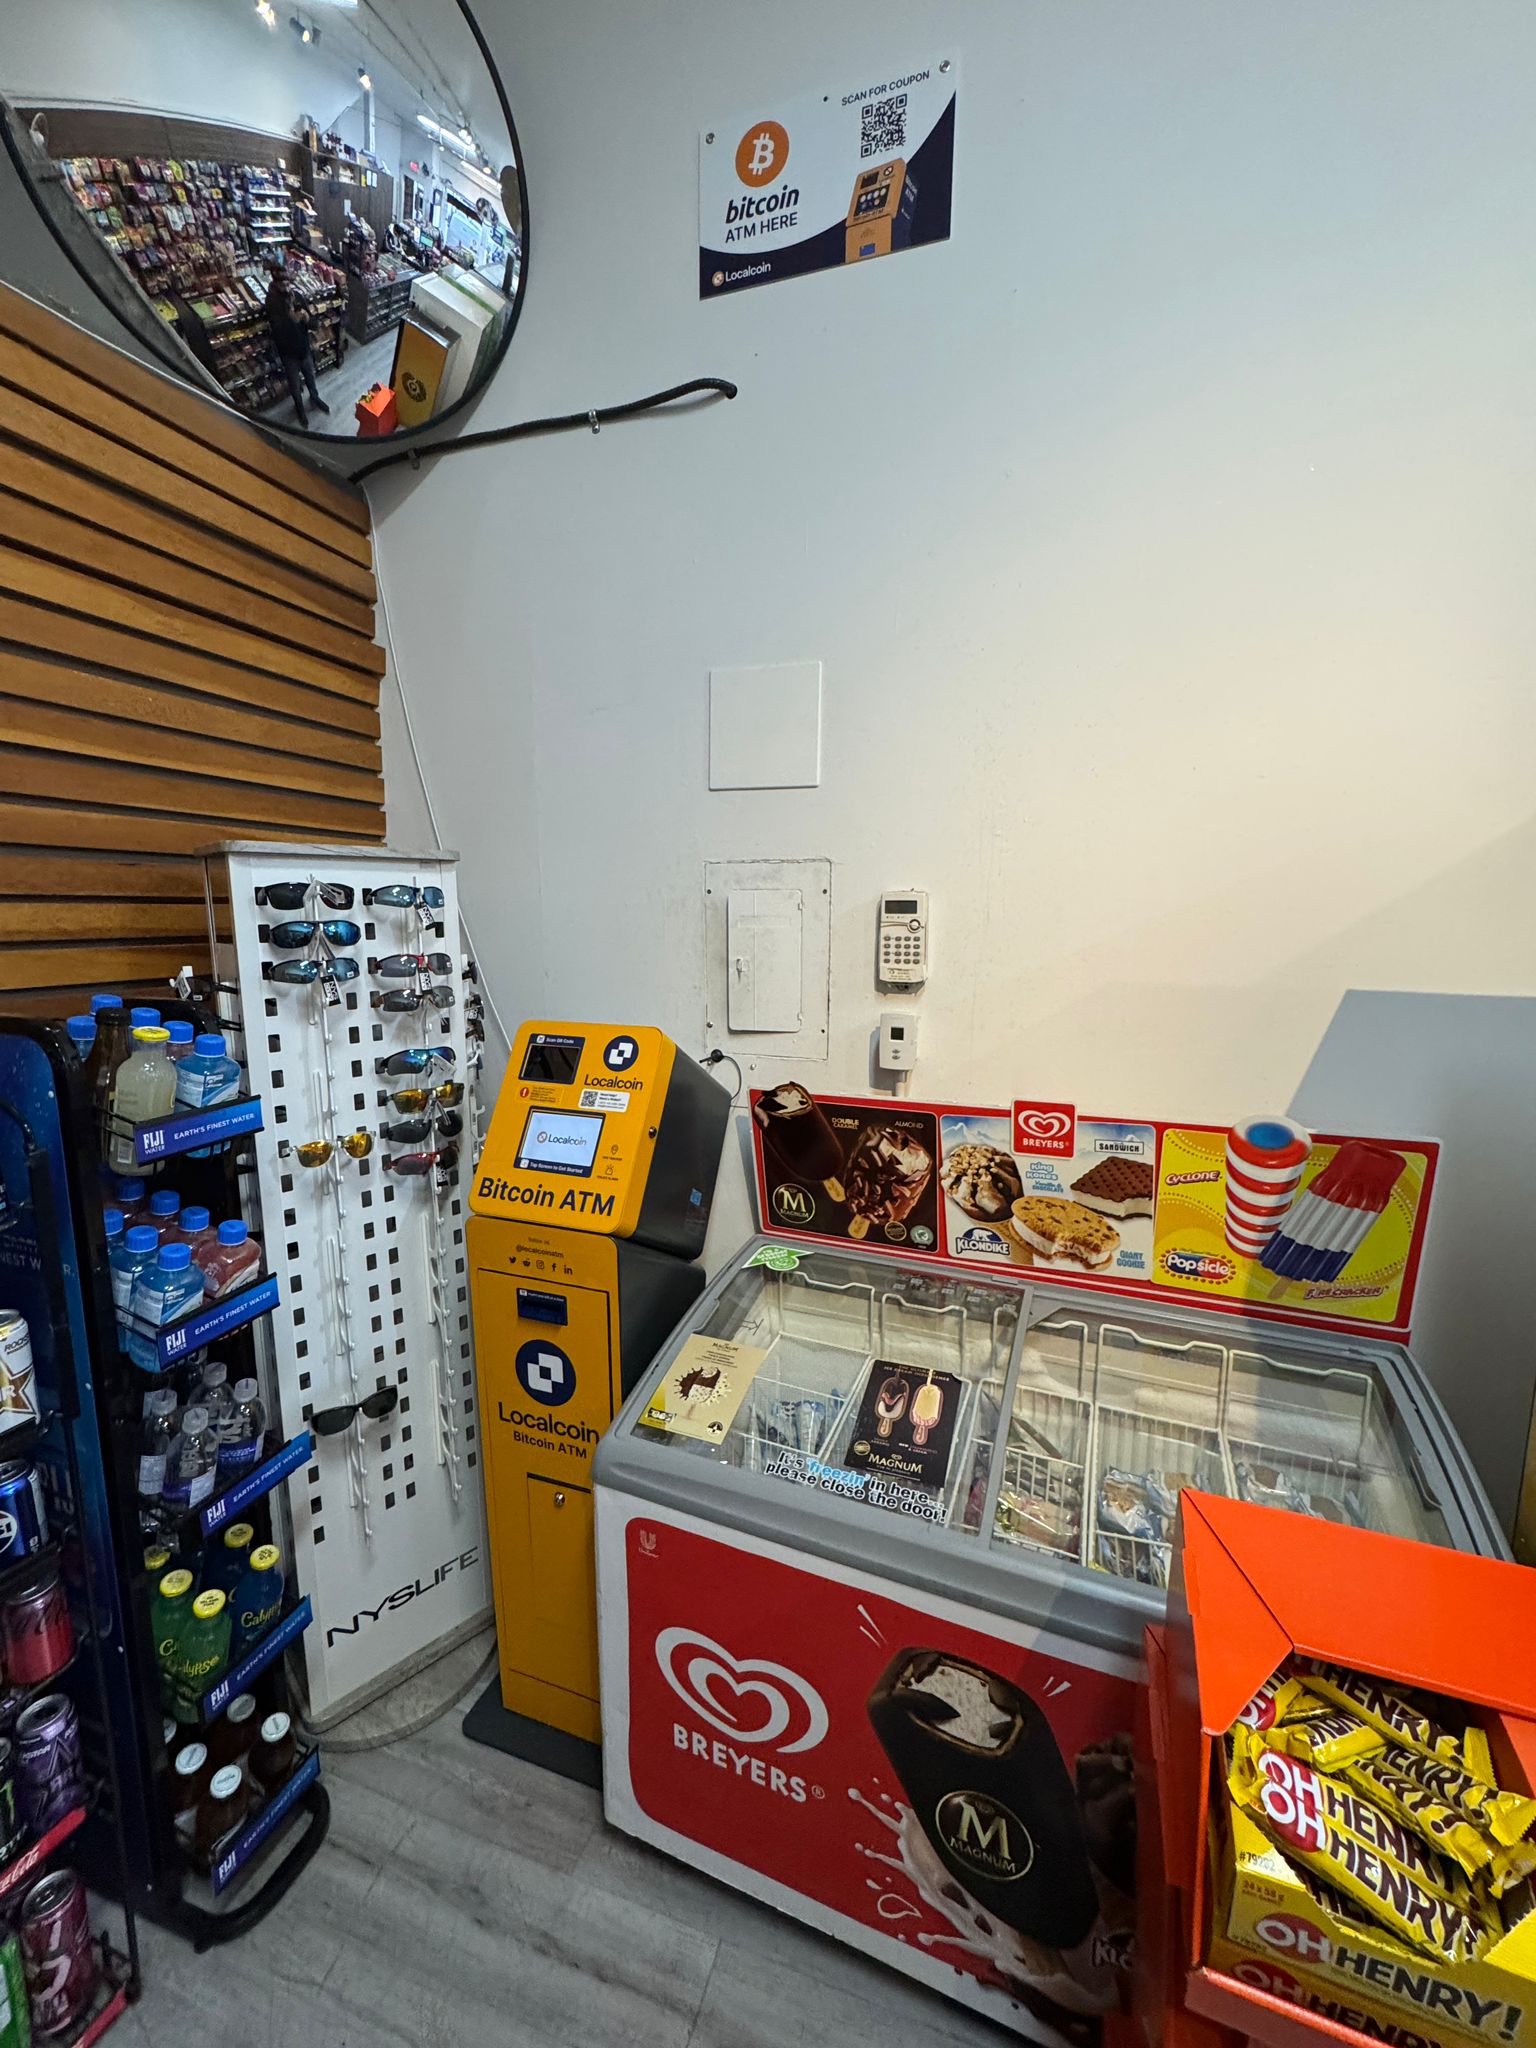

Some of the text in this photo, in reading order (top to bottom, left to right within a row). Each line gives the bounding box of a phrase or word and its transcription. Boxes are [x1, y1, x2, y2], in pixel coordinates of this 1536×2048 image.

[842, 70, 930, 106] SCAN FOR COUPON
[725, 184, 800, 225] bitcoin
[725, 211, 798, 244] ATM HERE
[725, 261, 772, 283] Localcoin
[584, 1074, 643, 1091] Localcoin
[143, 1112, 255, 1149] FIJI EARTH'S FINEST WATER
[548, 1134, 587, 1146] Localcoin
[1022, 1138, 1065, 1150] BREYERS
[1098, 1142, 1140, 1153] SANDWICH
[145, 1145, 165, 1156] WATER
[478, 1177, 616, 1217] Bitcoin ATM
[956, 1236, 1010, 1257] KLONDIKE
[1116, 1257, 1145, 1269] COOKIE
[1119, 1250, 1144, 1261] GIANT
[1166, 1253, 1231, 1276] Popsicle
[165, 1290, 271, 1351] FIJI EARTH'S FINEST WATER
[168, 1342, 187, 1356] WATER
[498, 1401, 600, 1444] Localcoin
[513, 1430, 588, 1460] Bitcoin ATM
[778, 1451, 945, 1509] It's 'freezin' in here...
[868, 1453, 923, 1474] MAGNUM
[206, 1446, 304, 1523] FIJI EARTH'S FINEST WATER
[765, 1462, 948, 1523] please close the door!
[327, 1545, 479, 1649] NYSLIFE
[210, 1679, 229, 1707] FIJI
[673, 1722, 807, 1803] BREYERS
[1258, 1750, 1325, 1812] OH
[1260, 1781, 1327, 1851] OH
[218, 1850, 237, 1883] FIJI
[950, 1836, 1017, 1874] MAGNUM
[1231, 1962, 1301, 2003] OH
[1255, 1919, 1523, 2042] OH HENRY!
